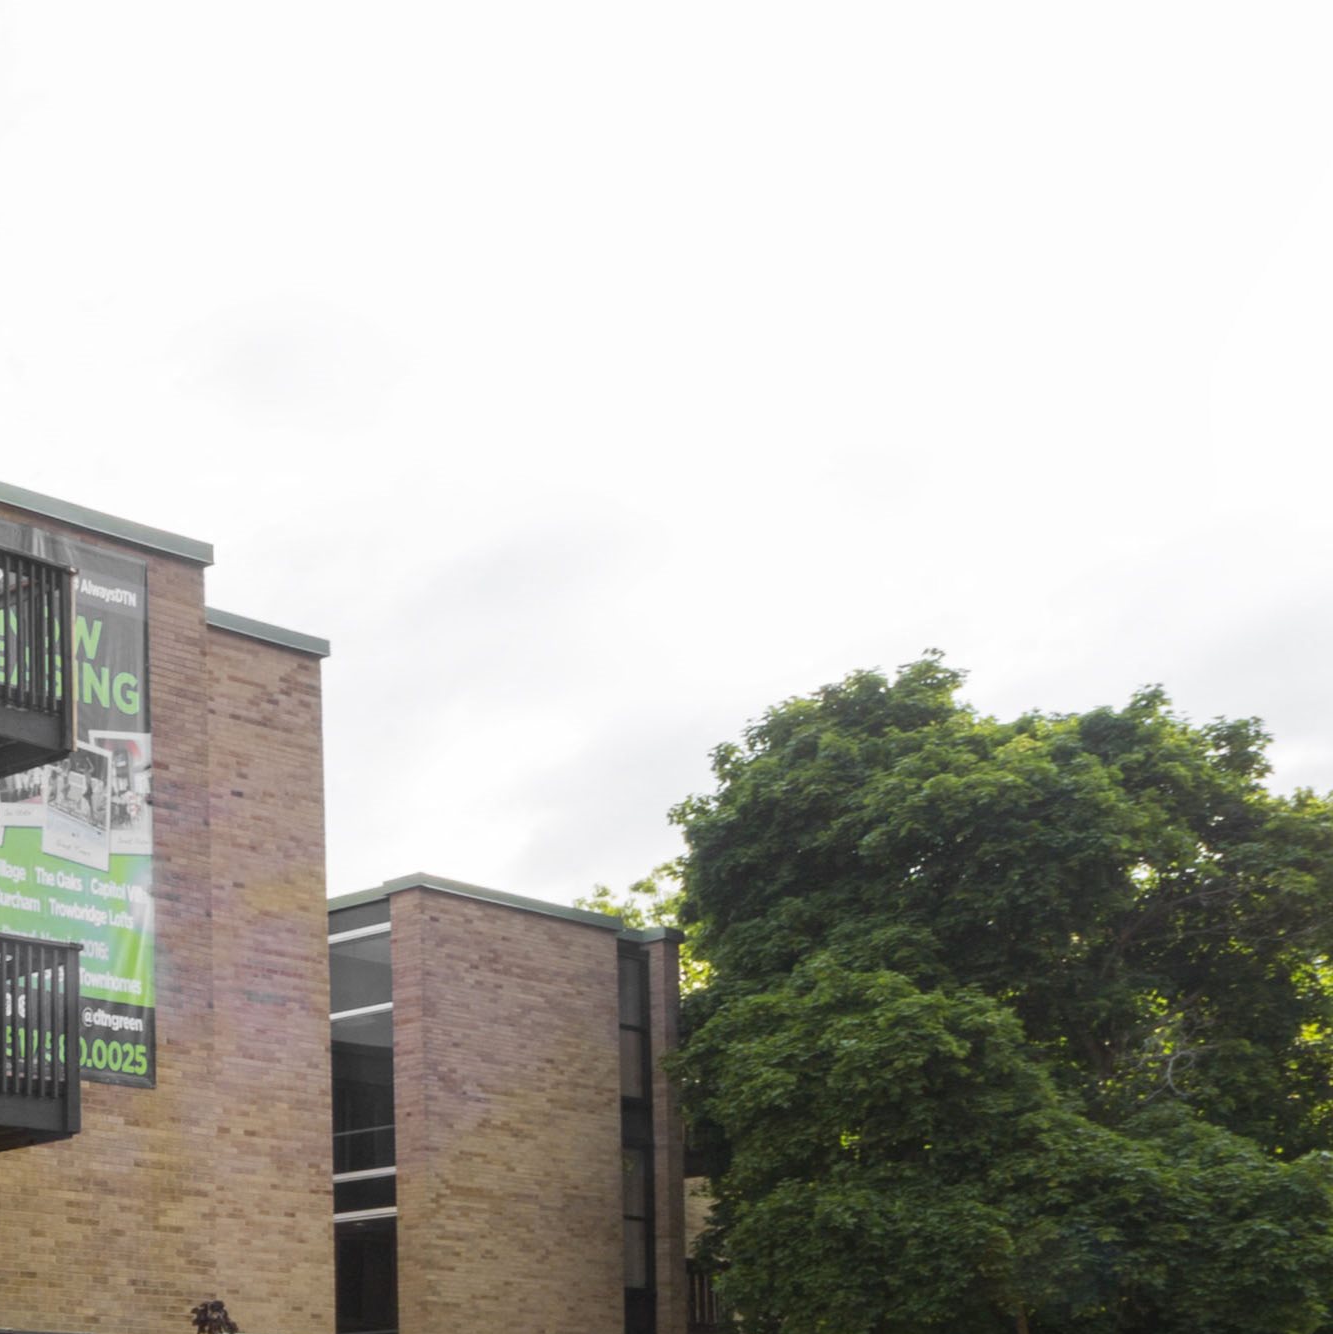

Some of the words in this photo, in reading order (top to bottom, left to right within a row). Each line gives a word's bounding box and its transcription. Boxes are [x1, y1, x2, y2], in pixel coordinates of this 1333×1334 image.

[80, 578, 137, 607] AlwaysDTN
[35, 866, 56, 887] The
[56, 871, 83, 892] Oaks
[91, 877, 127, 900] Capitol
[48, 897, 108, 927] Trowbridge
[108, 909, 134, 930] Lofts
[79, 966, 142, 995] Townhomes
[84, 1007, 144, 1031] @dtngreen
